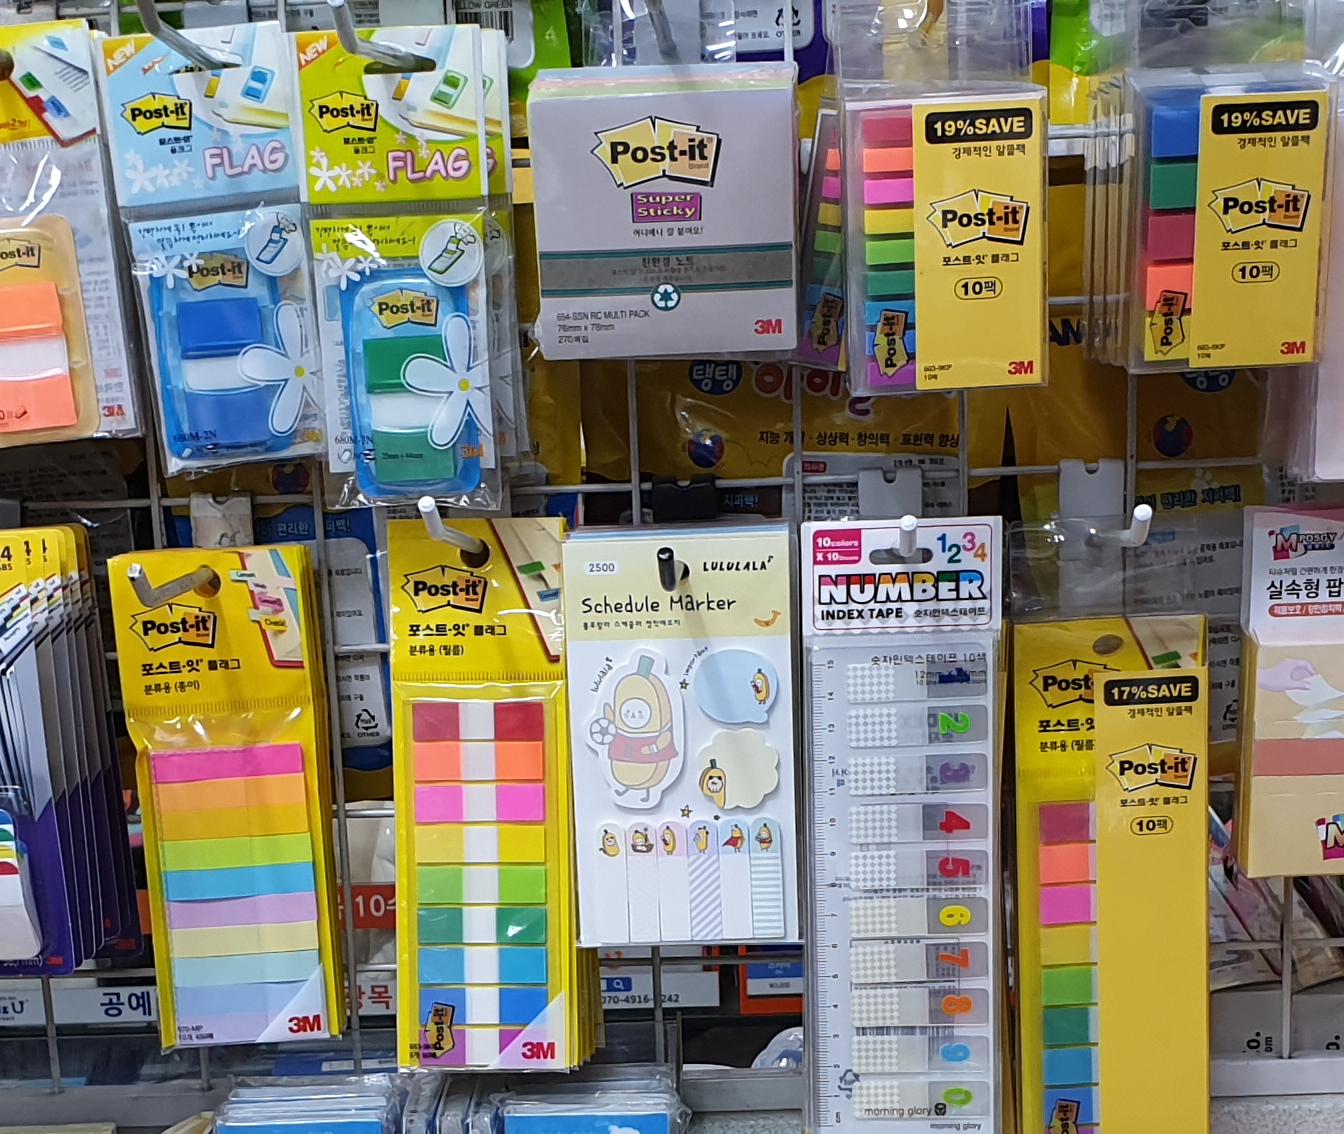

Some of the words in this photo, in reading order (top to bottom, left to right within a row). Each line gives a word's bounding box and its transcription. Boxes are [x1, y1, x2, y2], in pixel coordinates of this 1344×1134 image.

[107, 40, 136, 69] NEW
[299, 40, 328, 66] NEW
[933, 117, 1026, 137] 19%SAVE
[1220, 110, 1310, 127] 19%SAVE
[1238, 137, 1277, 149] 경제적인
[204, 146, 286, 180] FLAG
[388, 149, 472, 182] FLAG
[637, 193, 693, 205] Super
[637, 205, 697, 219] Sticky
[1238, 264, 1273, 279] 10팩
[960, 279, 997, 296] 10팩
[754, 319, 782, 335] 3M
[1007, 361, 1033, 375] 3M
[589, 563, 615, 572] 2500
[703, 561, 767, 572] LULULALA
[819, 570, 987, 605] NUMBER
[1266, 578, 1319, 600] 실속형
[582, 595, 660, 614] Schedule
[670, 593, 736, 612] Marker
[821, 609, 866, 620] INDEX
[868, 608, 902, 619] TAPE
[1111, 683, 1192, 700] 17%SAVE
[1136, 819, 1168, 832] 10팩
[288, 1015, 322, 1033] 3M
[522, 1042, 555, 1059] 3M
